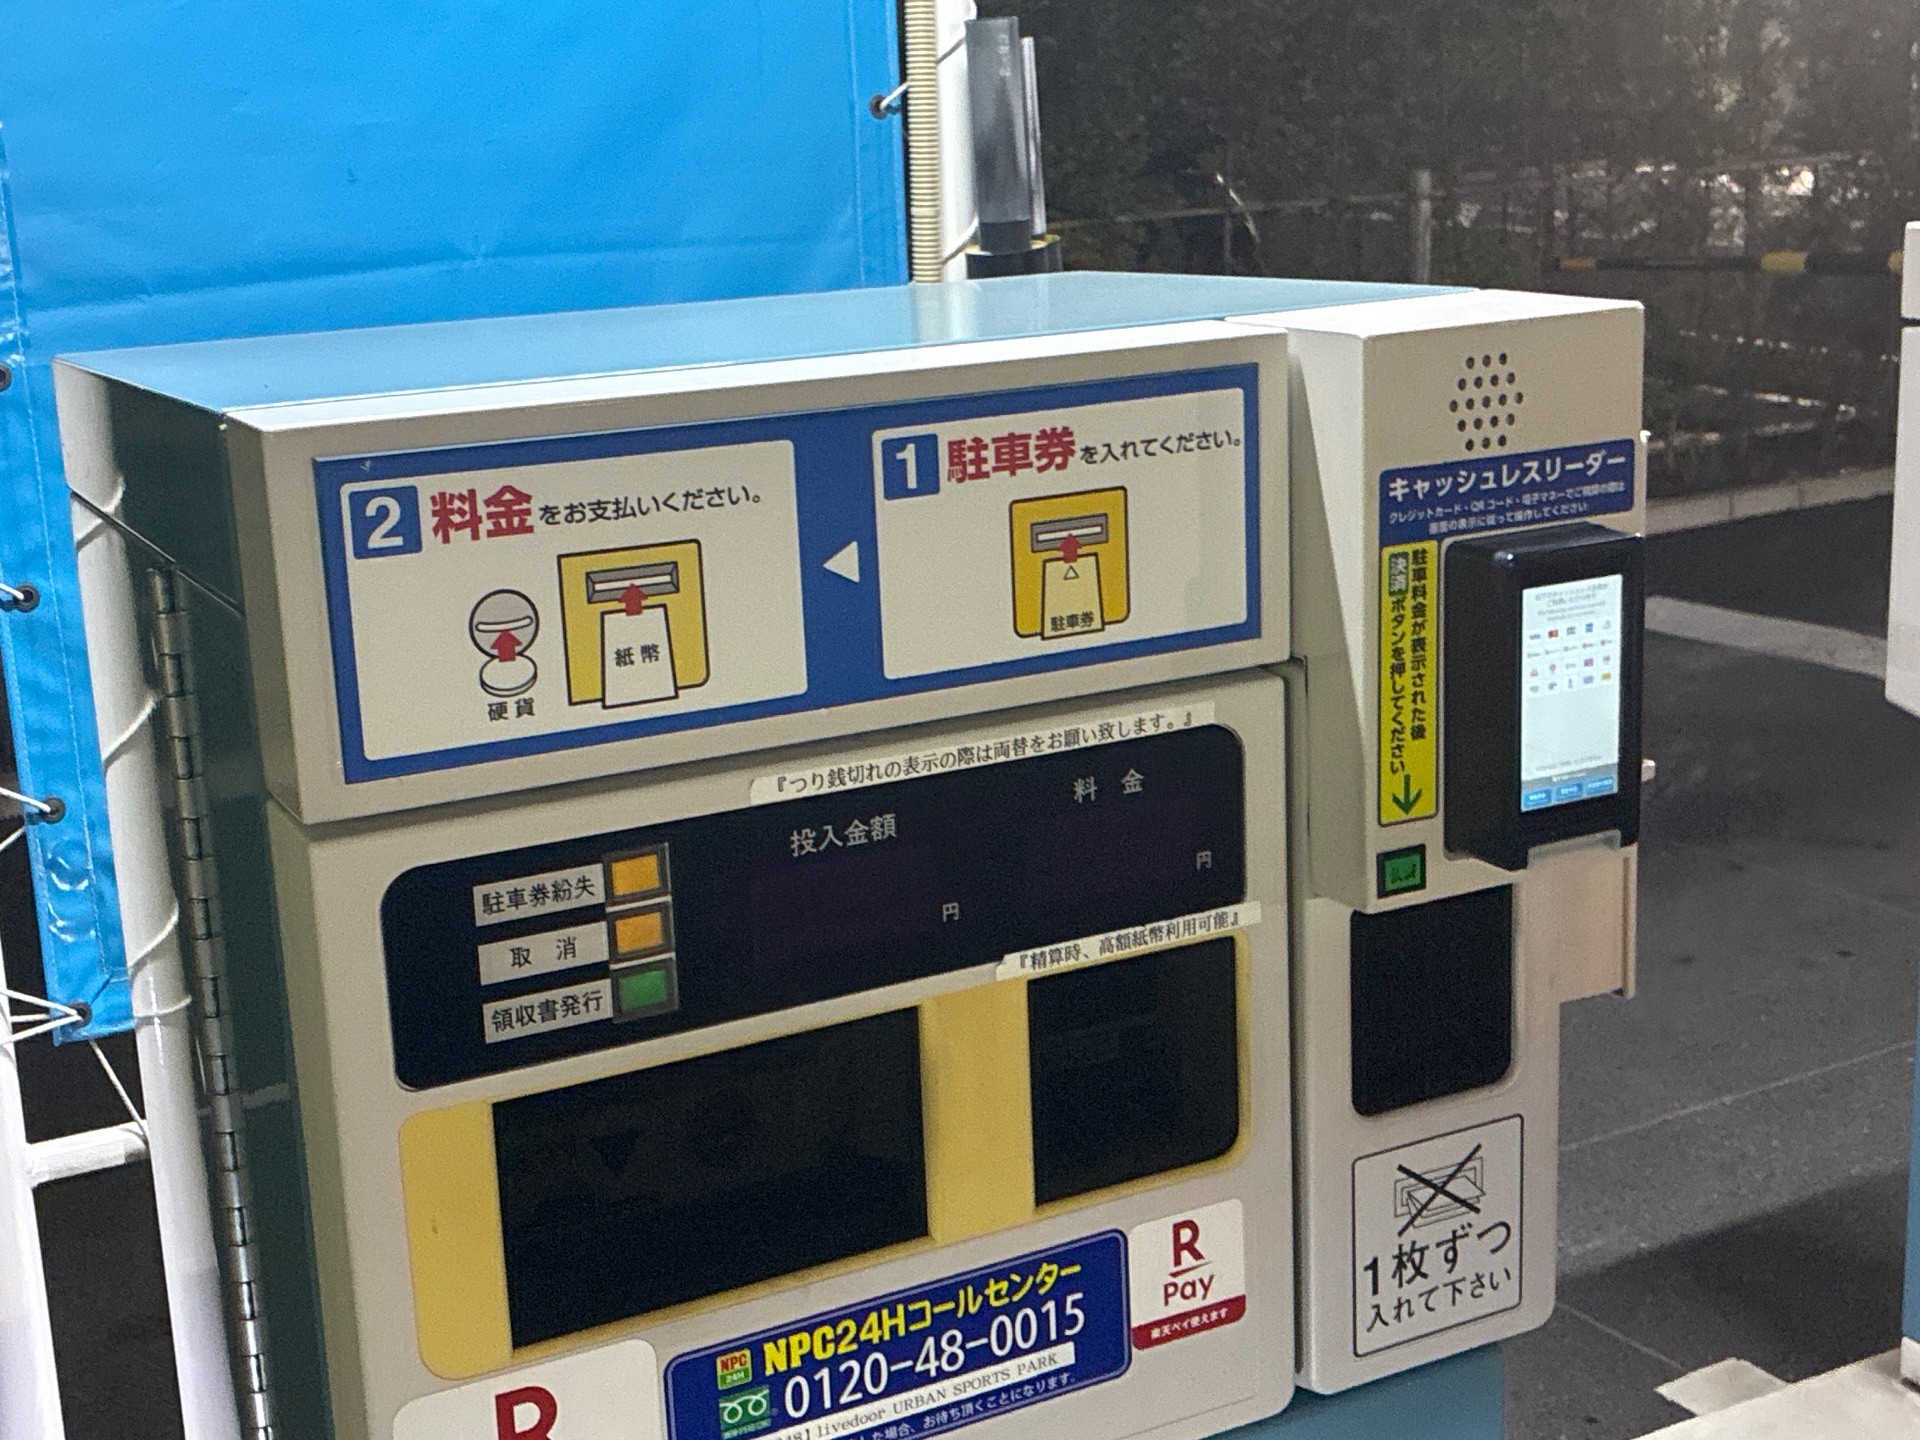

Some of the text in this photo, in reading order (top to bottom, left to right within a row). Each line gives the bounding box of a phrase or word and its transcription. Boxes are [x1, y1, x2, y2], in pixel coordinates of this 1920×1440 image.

[895, 444, 917, 490] 1
[1388, 449, 1626, 502] キャッシュレスリーダー
[363, 496, 404, 550] 2
[1050, 611, 1095, 632] 駐車券
[614, 643, 661, 667] 紙幣
[487, 697, 536, 723] 硬貨
[789, 813, 898, 858] 投入金額
[1195, 851, 1213, 870] 円
[481, 874, 596, 916] 駐車券紛失
[942, 902, 960, 922] 円
[490, 989, 604, 1033] 領収書発行
[1172, 1219, 1206, 1268] R
[1363, 1221, 1512, 1297] 1枚ずつ
[1366, 1267, 1513, 1333] 入れて下さい
[719, 1353, 748, 1373] NPC
[725, 1369, 746, 1383] 24H
[784, 1291, 1085, 1419] 0120-48-0015
[817, 1408, 886, 1438] livedoor
[892, 1387, 947, 1414] URBAN
[952, 1368, 1011, 1397] SPORTS
[1016, 1351, 1059, 1376] PARK
